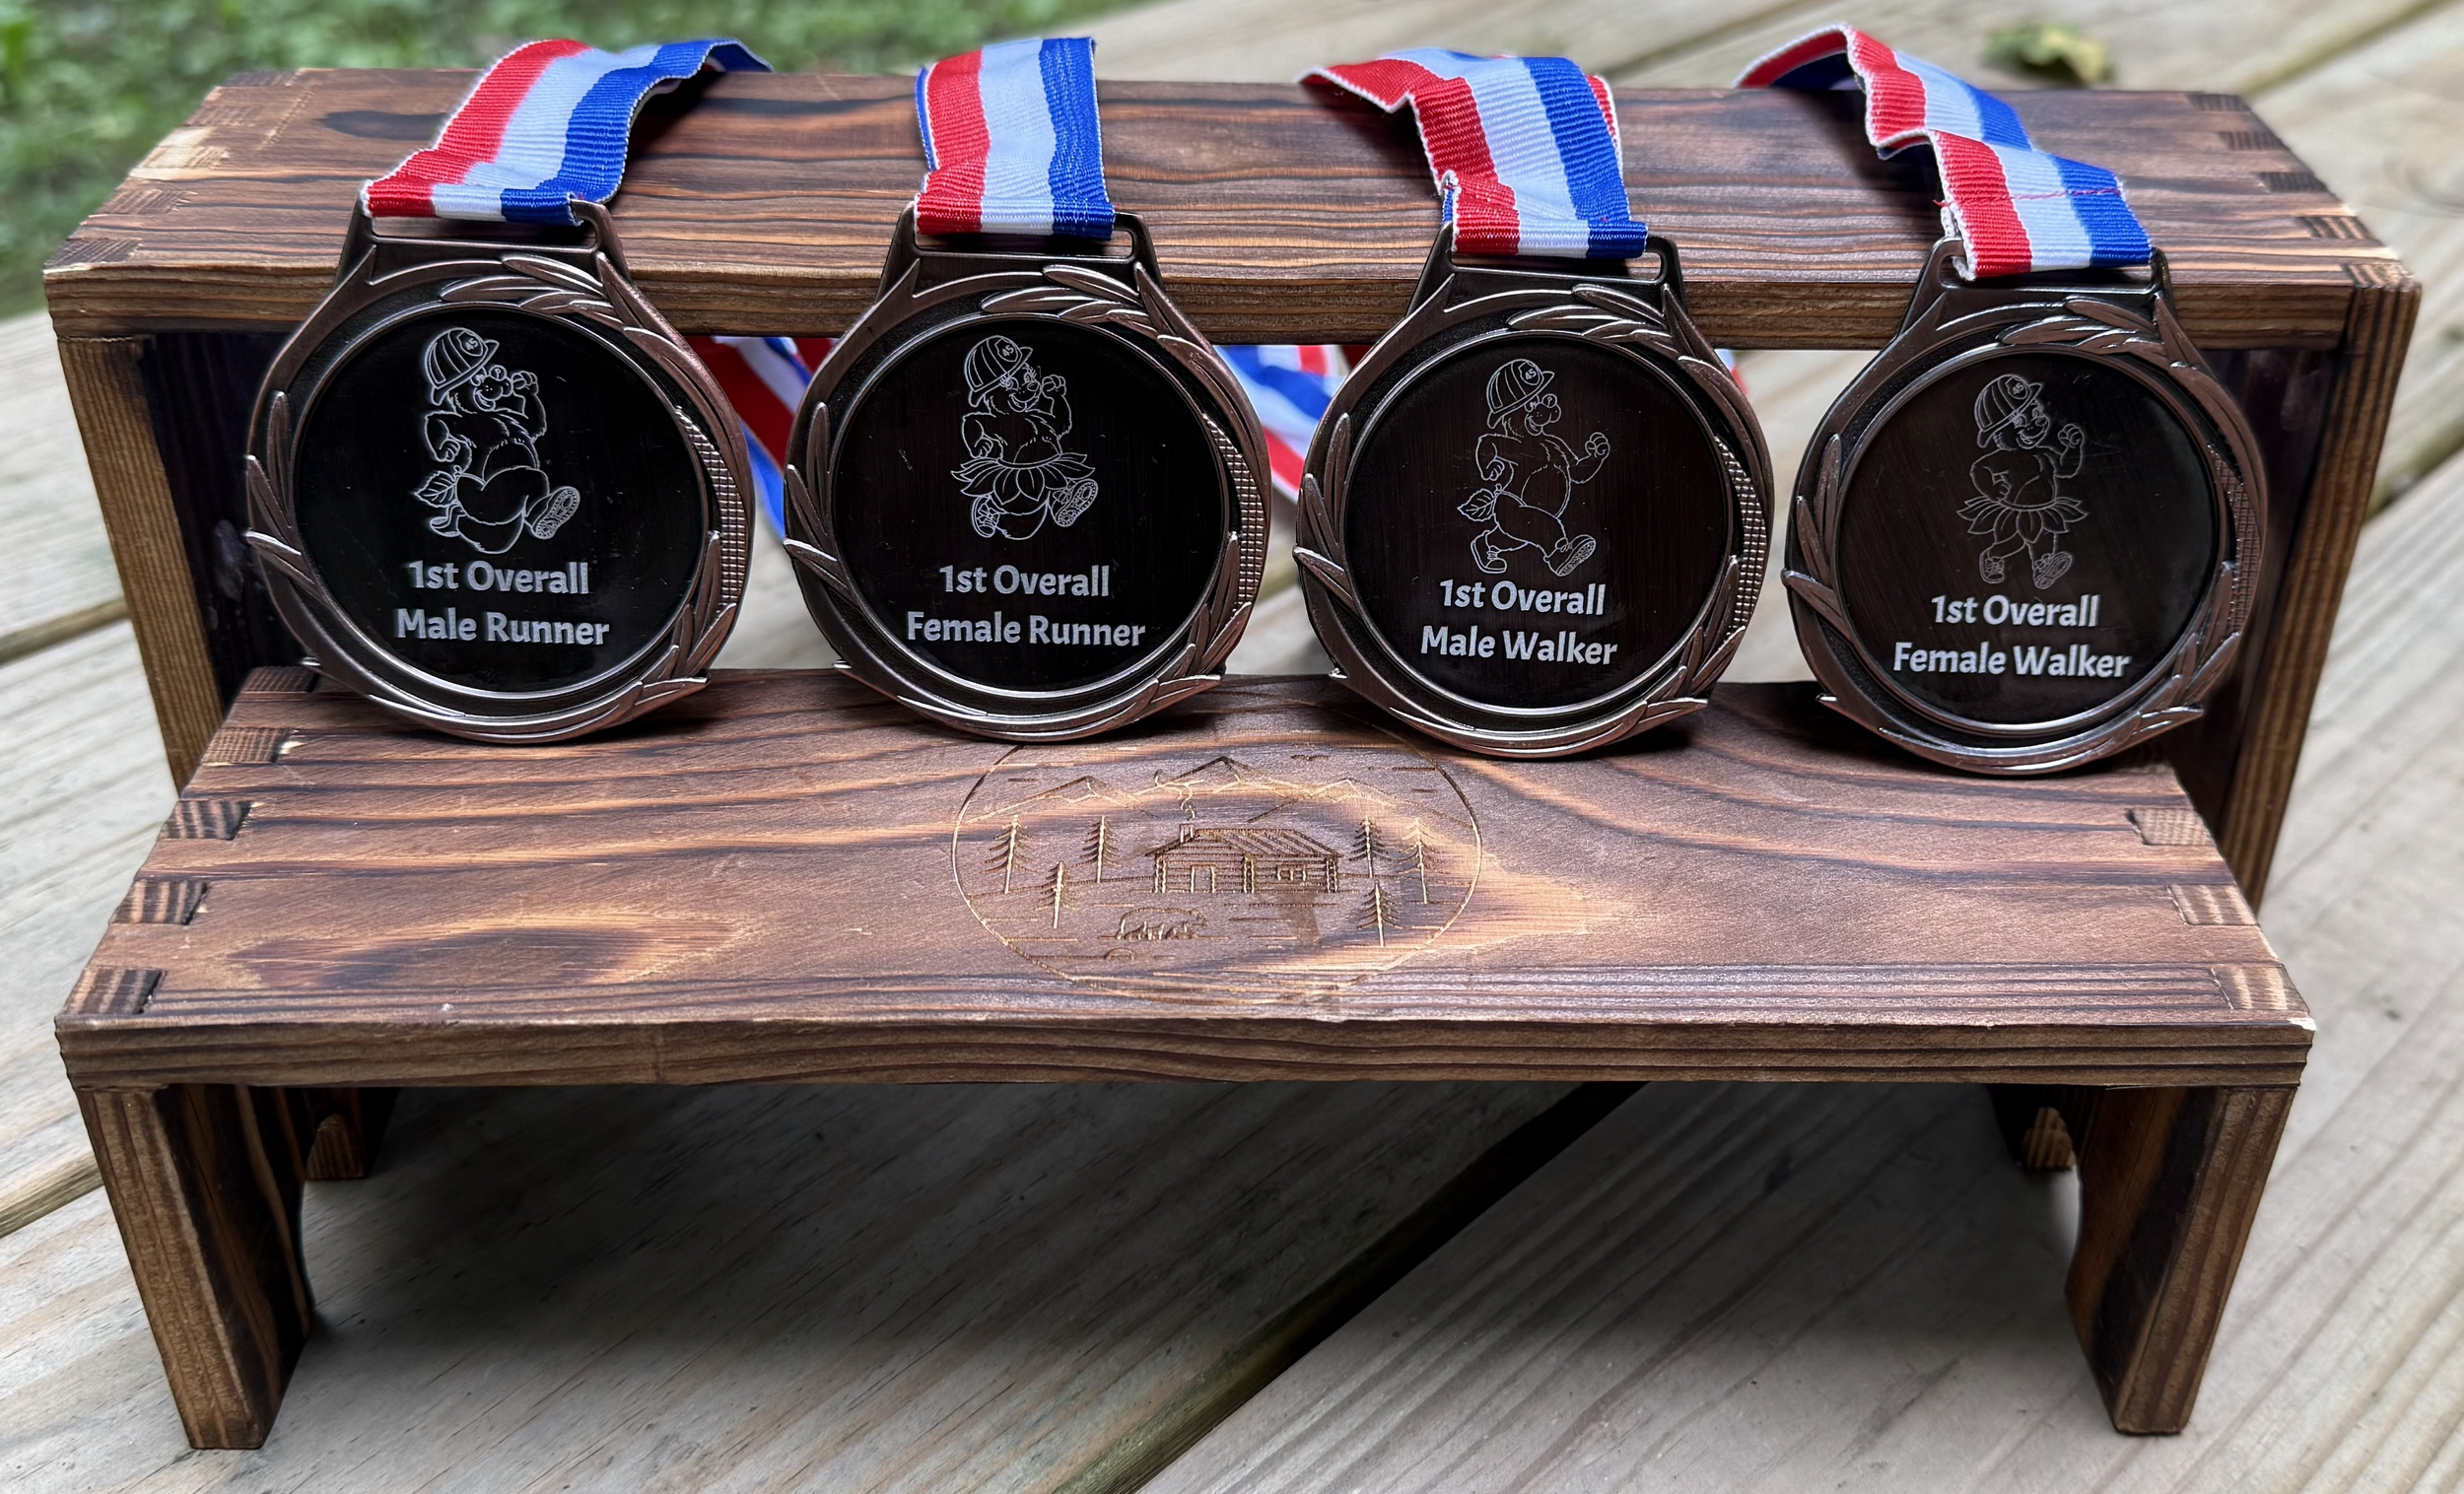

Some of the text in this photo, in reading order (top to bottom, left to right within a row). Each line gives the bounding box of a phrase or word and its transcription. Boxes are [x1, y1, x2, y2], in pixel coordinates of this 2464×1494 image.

[464, 337, 479, 352] 45
[1001, 345, 1015, 358] 45
[1525, 368, 1538, 380] 45
[2012, 382, 2024, 395] 45
[409, 561, 588, 595] 1st Overall
[939, 565, 1109, 597] 1st Overall
[1439, 578, 1607, 616] 1st Overall
[1931, 594, 2100, 628] 1st Overall
[396, 608, 609, 646] Male Runner
[907, 611, 1145, 646] Female Runner
[1420, 625, 1618, 665] Male Walker
[1892, 642, 2131, 678] Female Walker
